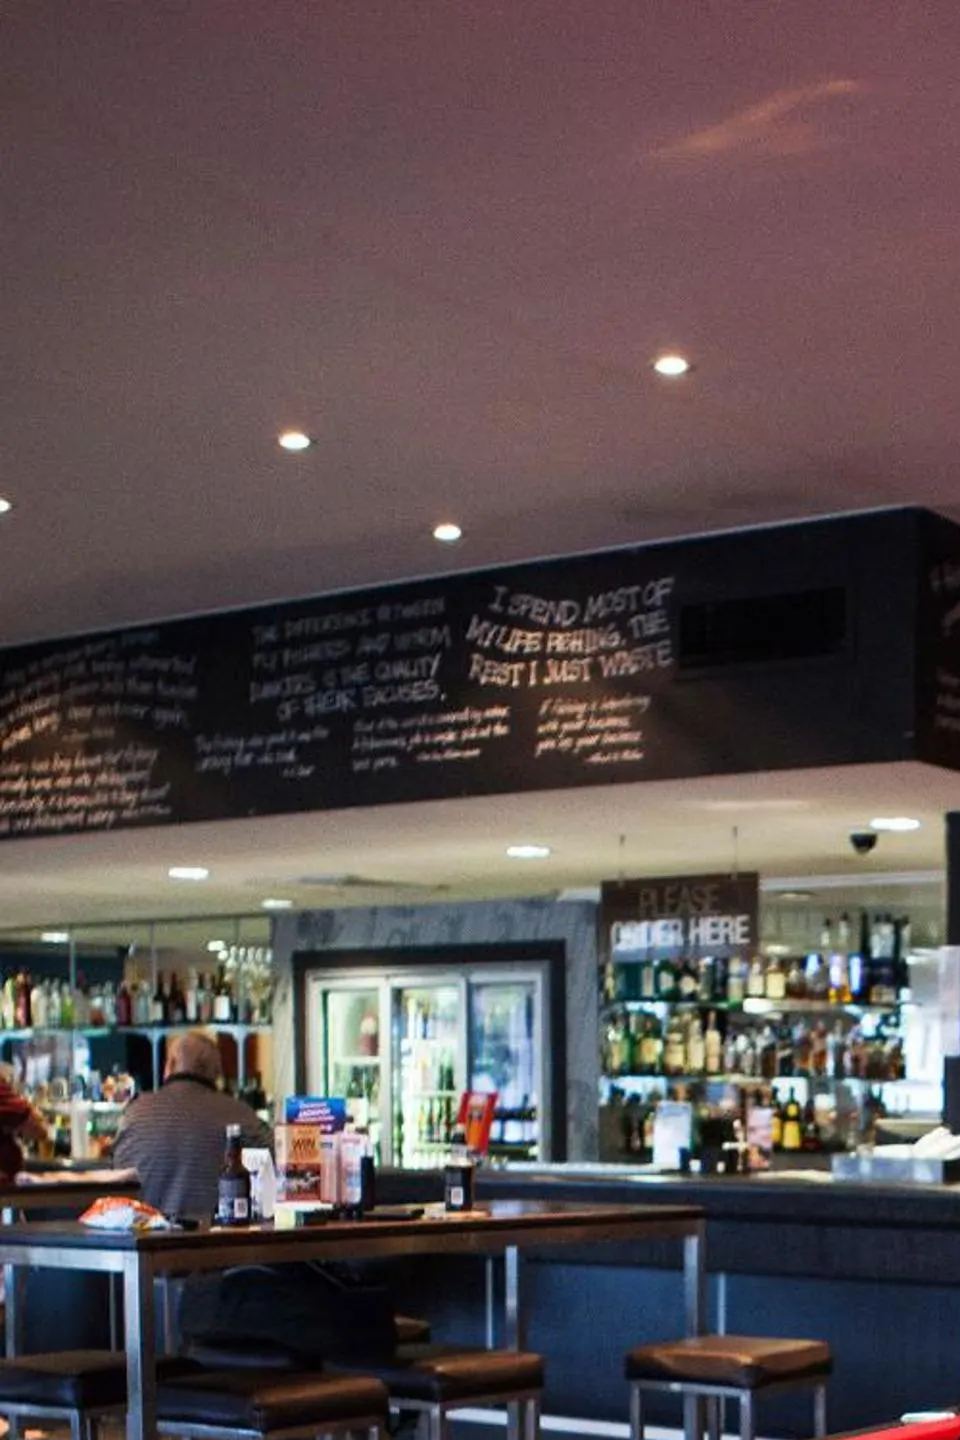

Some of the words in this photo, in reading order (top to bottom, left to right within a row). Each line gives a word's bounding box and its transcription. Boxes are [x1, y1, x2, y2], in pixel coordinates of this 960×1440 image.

[583, 586, 641, 622] MOST
[543, 657, 592, 684] JUST
[639, 884, 721, 918] PLEASE
[610, 918, 684, 950] ORDER
[689, 914, 751, 946] HERE
